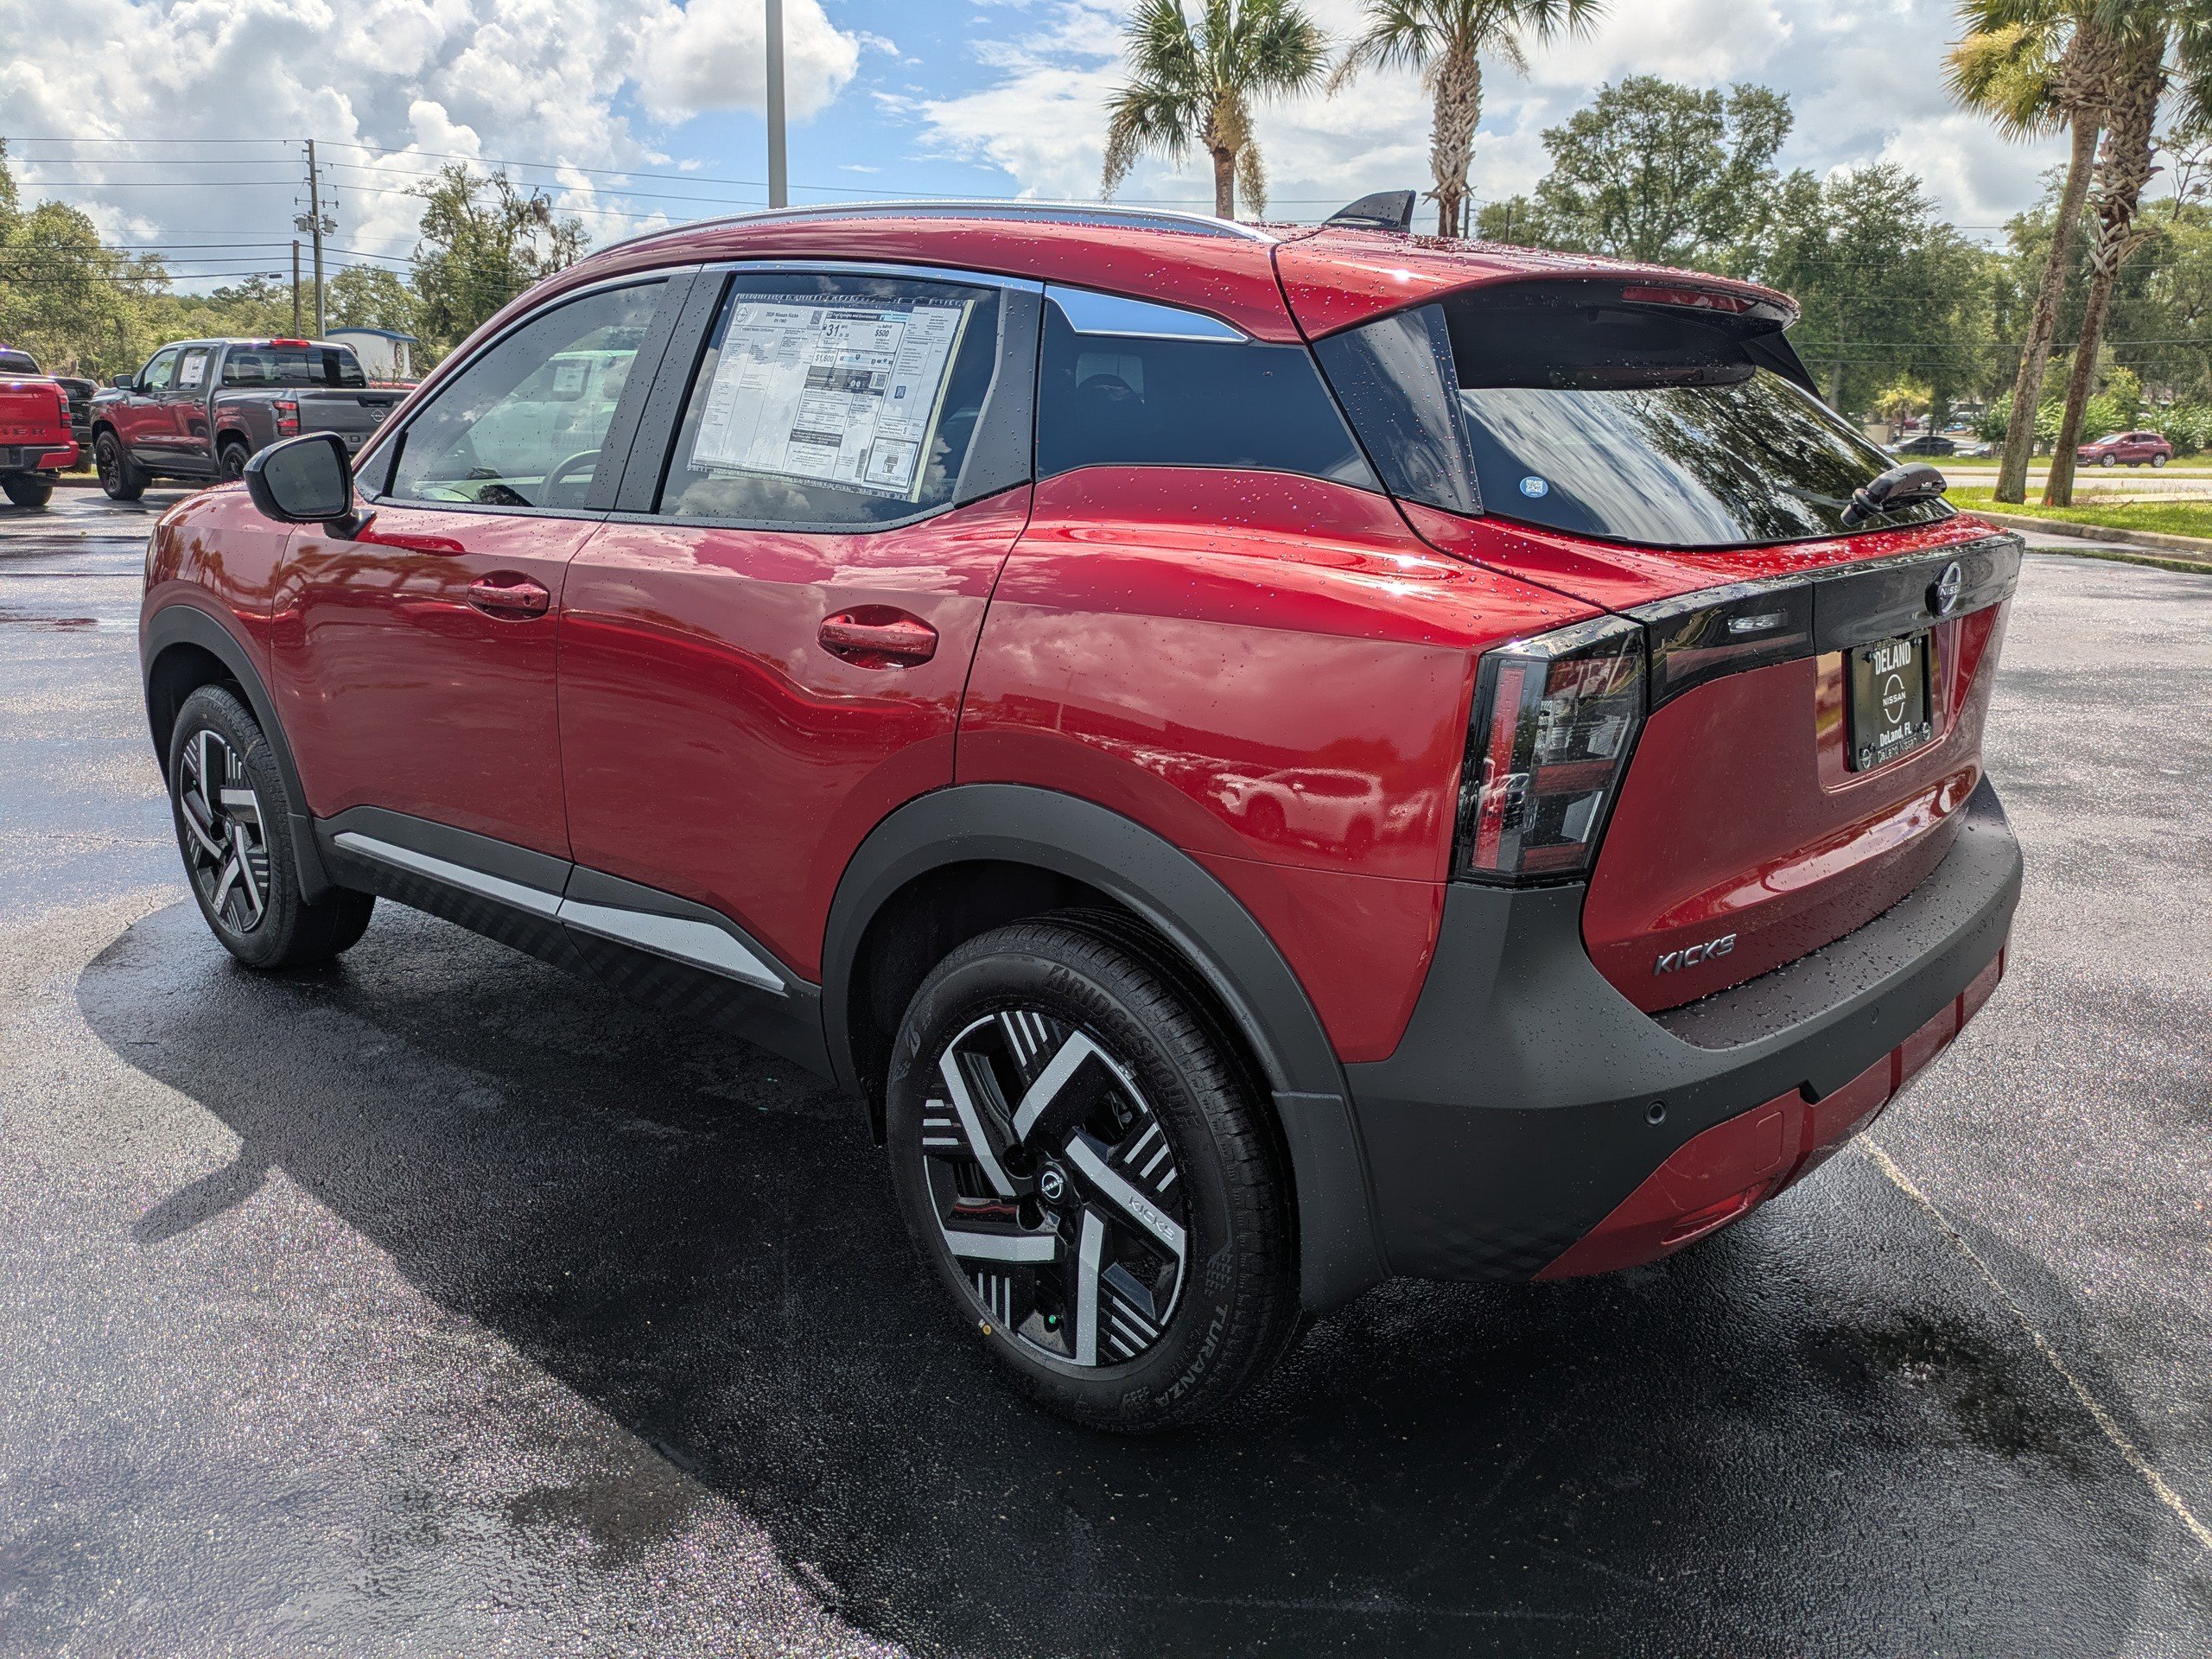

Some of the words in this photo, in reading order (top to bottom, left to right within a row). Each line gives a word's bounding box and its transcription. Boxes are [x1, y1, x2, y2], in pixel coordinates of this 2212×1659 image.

[826, 324, 840, 337] 31
[874, 328, 890, 337] $500
[815, 354, 835, 363] $1,600
[1874, 640, 1911, 676] DELAND
[1882, 690, 1906, 707] NISSAN
[1879, 725, 1904, 747] DeLand,
[1904, 721, 1912, 736] FL
[1653, 933, 1737, 976] KICKS
[1044, 963, 1201, 1128] BRIDGESTONE
[1041, 1177, 1064, 1192] NISSAN
[1128, 1196, 1175, 1241] KICKS
[1154, 1303, 1229, 1408] TURANZA
